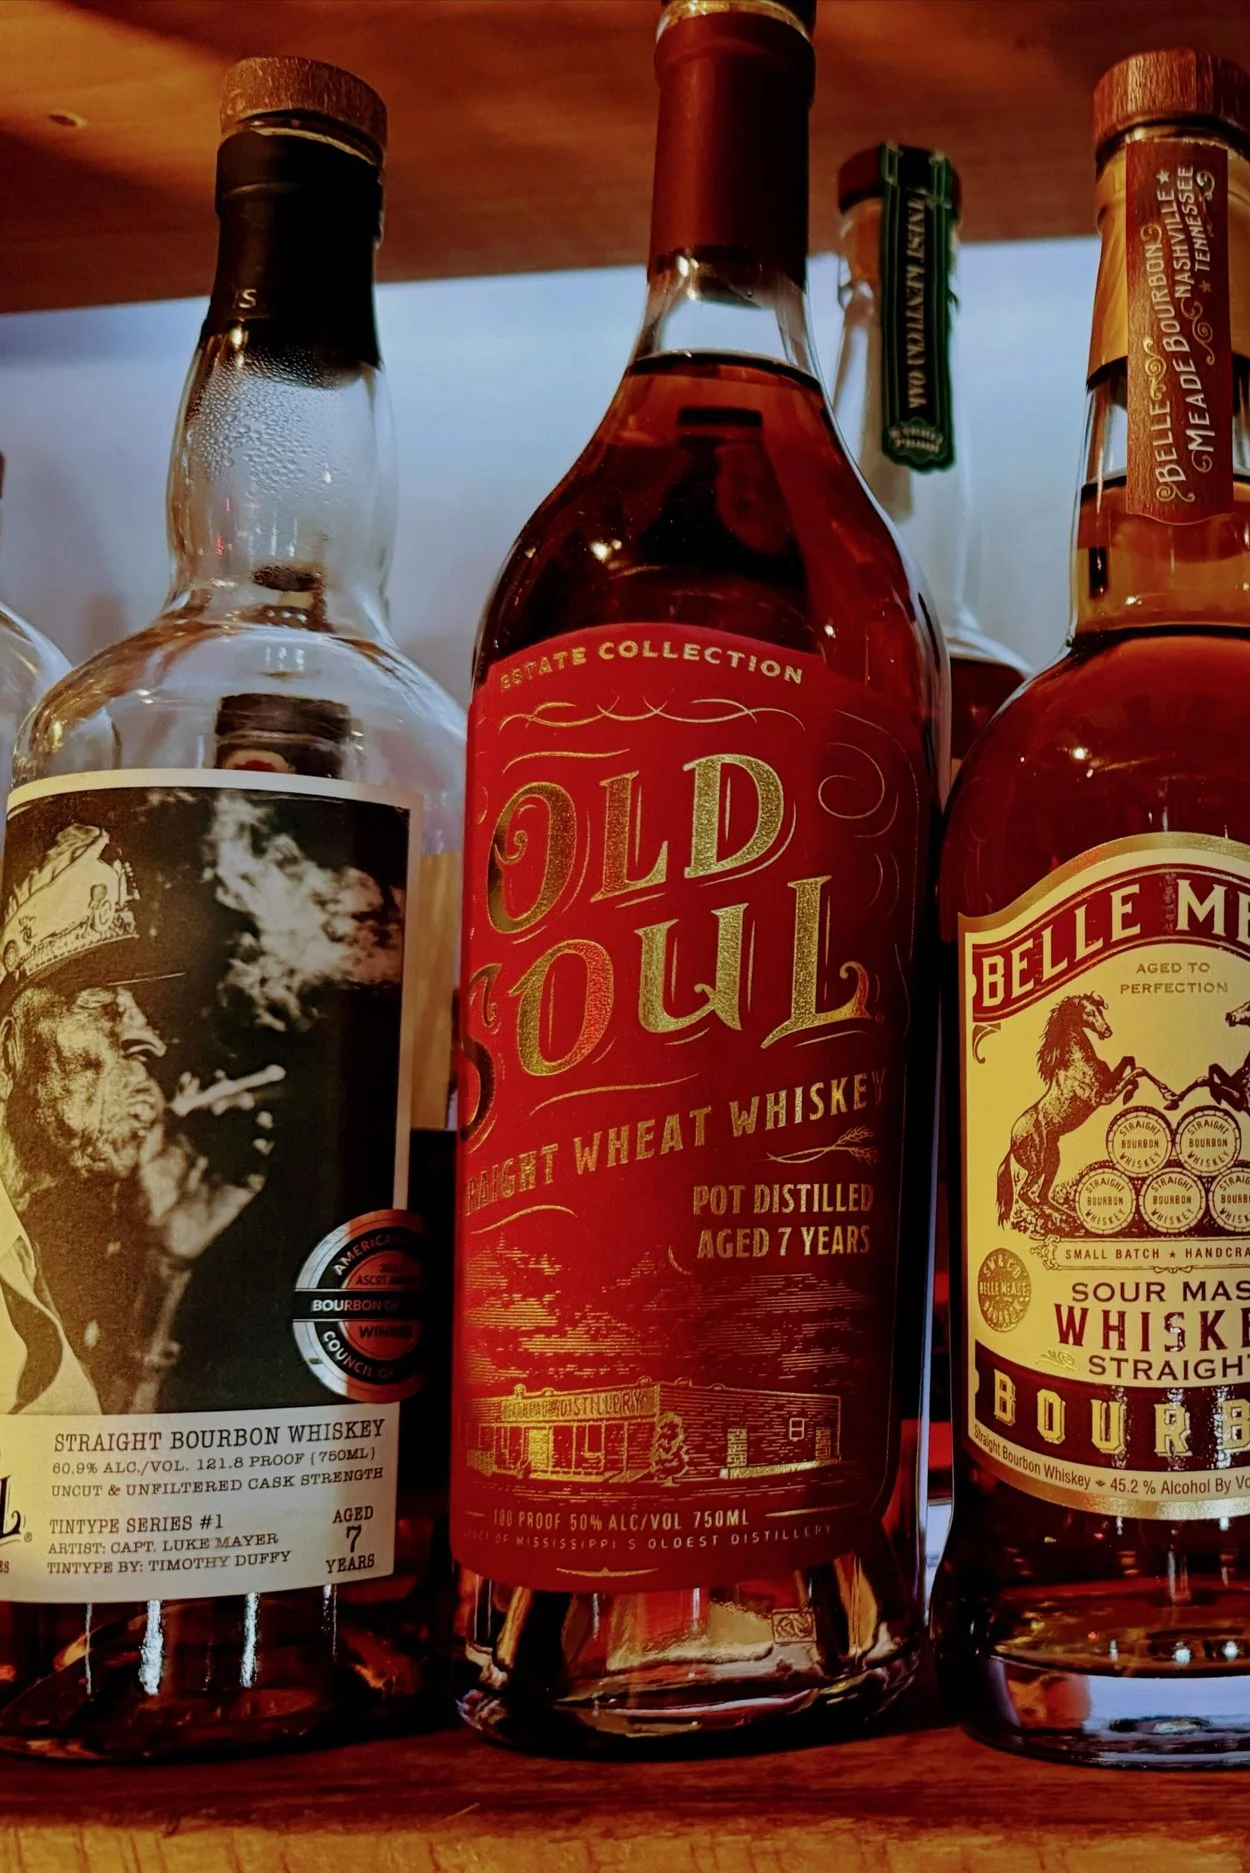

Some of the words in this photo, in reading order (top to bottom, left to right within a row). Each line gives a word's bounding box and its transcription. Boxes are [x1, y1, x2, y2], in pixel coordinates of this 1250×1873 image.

[1177, 166, 1211, 271] TENNESSEE
[1157, 189, 1195, 298] NASHVILLE
[1144, 243, 1191, 353] BOURBON
[1172, 358, 1216, 452] MEADE
[1150, 400, 1187, 483] BELLE
[500, 646, 587, 692] ESTATE
[599, 640, 804, 685] COLLECTION
[487, 753, 785, 934] OLD
[980, 883, 1141, 1008] BELLE
[1136, 961, 1182, 975] AGED
[1187, 961, 1211, 975] TO
[1120, 980, 1229, 995] PERFECTION
[573, 1105, 712, 1177] WHEAT
[729, 1069, 886, 1138] WHISKEY
[1120, 1120, 1160, 1137] STRAIGHT
[1121, 1139, 1160, 1148] BOURBON
[1119, 1151, 1162, 1169] WHISKEY
[693, 1184, 746, 1215] POT
[754, 1183, 875, 1215] DISTILLED
[697, 1227, 770, 1259] AGED
[777, 1227, 791, 1257] 7
[802, 1225, 871, 1257] YEARS
[1065, 1248, 1108, 1260] SMALL
[1115, 1247, 1160, 1259] BATCH
[311, 1299, 382, 1312] BOURBON
[1071, 1281, 1166, 1302] SOUR
[322, 1331, 373, 1377] COUNCIL
[560, 1390, 642, 1418] DISTILLERY
[54, 1431, 162, 1452] STRAIGHT
[170, 1426, 280, 1450] BOURBON
[287, 1419, 385, 1444] WHISKEY
[52, 1462, 98, 1475] 60.9%
[103, 1460, 189, 1476] ALC./VOL.
[197, 1457, 244, 1470] 121.8
[249, 1453, 305, 1468] PROOF
[974, 1425, 1001, 1454] Straight
[1002, 1443, 1041, 1474] Bourbon
[1043, 1463, 1091, 1490] Whiskey
[1110, 1478, 1138, 1493] 45.2
[1160, 1479, 1210, 1495] Alcohol
[1215, 1478, 1232, 1494] By
[52, 1484, 103, 1497] UNCUT
[126, 1479, 242, 1496] UNFILTERED
[248, 1475, 295, 1490] CASK
[301, 1467, 384, 1486] STRENGTH
[49, 1518, 120, 1535] TINTYPE
[126, 1515, 193, 1533] SERIES
[199, 1514, 224, 1530] #1
[333, 1505, 374, 1524] AGED
[493, 1507, 513, 1527] 100
[518, 1511, 562, 1530] PROOF
[570, 1513, 602, 1532] 50%
[608, 1512, 683, 1532] ALC/VOL
[693, 1508, 750, 1528] 750ML
[48, 1543, 106, 1555] ARTIST:
[110, 1541, 157, 1554] CAPT.
[162, 1537, 210, 1552] LUKE
[215, 1533, 279, 1549] MAYER
[345, 1524, 362, 1553] 7
[731, 1523, 832, 1546] DISTILLERY
[47, 1562, 114, 1575] TINTYPE
[118, 1561, 144, 1573] BY:
[149, 1555, 230, 1572] TIMOTHY
[235, 1550, 292, 1567] DUFFY
[325, 1553, 376, 1574] YEARS
